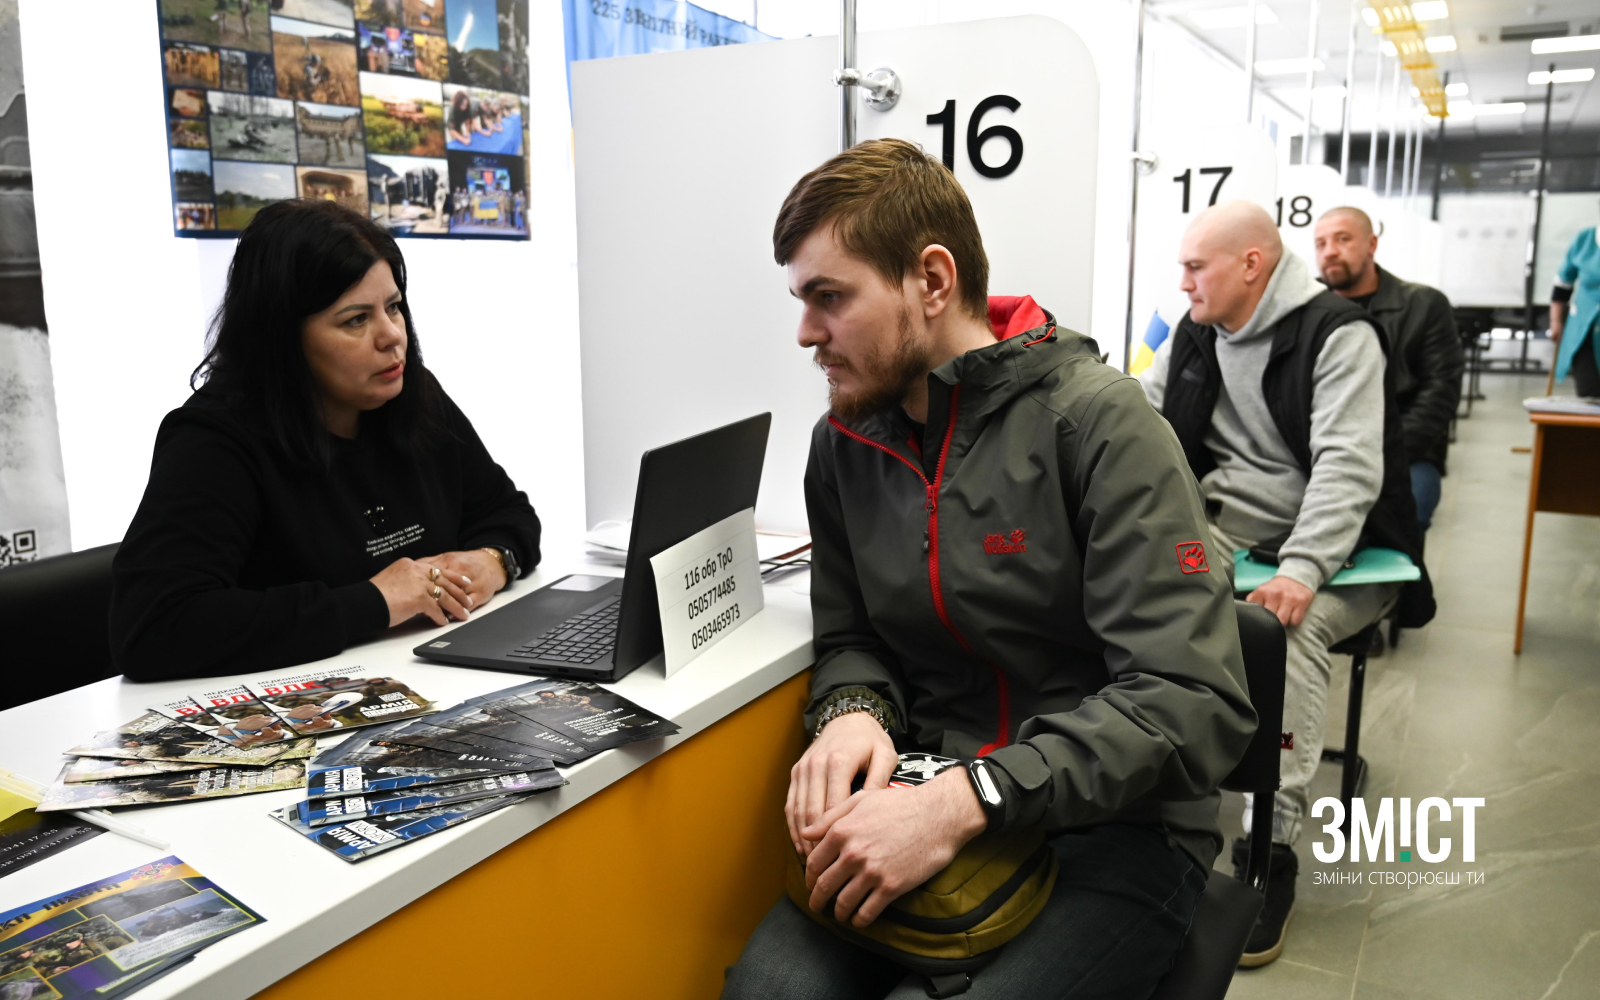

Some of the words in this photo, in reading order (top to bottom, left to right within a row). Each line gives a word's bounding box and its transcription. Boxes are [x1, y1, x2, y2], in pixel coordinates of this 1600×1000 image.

[592, 0, 621, 20] 225
[926, 94, 1024, 179] 16
[1173, 166, 1233, 213] 17
[1276, 196, 1313, 228] 18
[983, 532, 1005, 544] Jack
[983, 542, 1027, 554] Wolfskin
[684, 566, 700, 591] 116
[701, 558, 717, 579] обр
[717, 547, 733, 570] ТрО
[688, 575, 736, 620] 0505774485
[691, 603, 741, 650] 0503465973
[264, 681, 324, 696] ВЛК
[360, 699, 414, 713] АРМІЯ
[324, 769, 341, 793] АРМІЯ
[345, 797, 366, 814] INFO
[326, 826, 377, 850] АРМІЯ
[344, 820, 397, 844] INFORM
